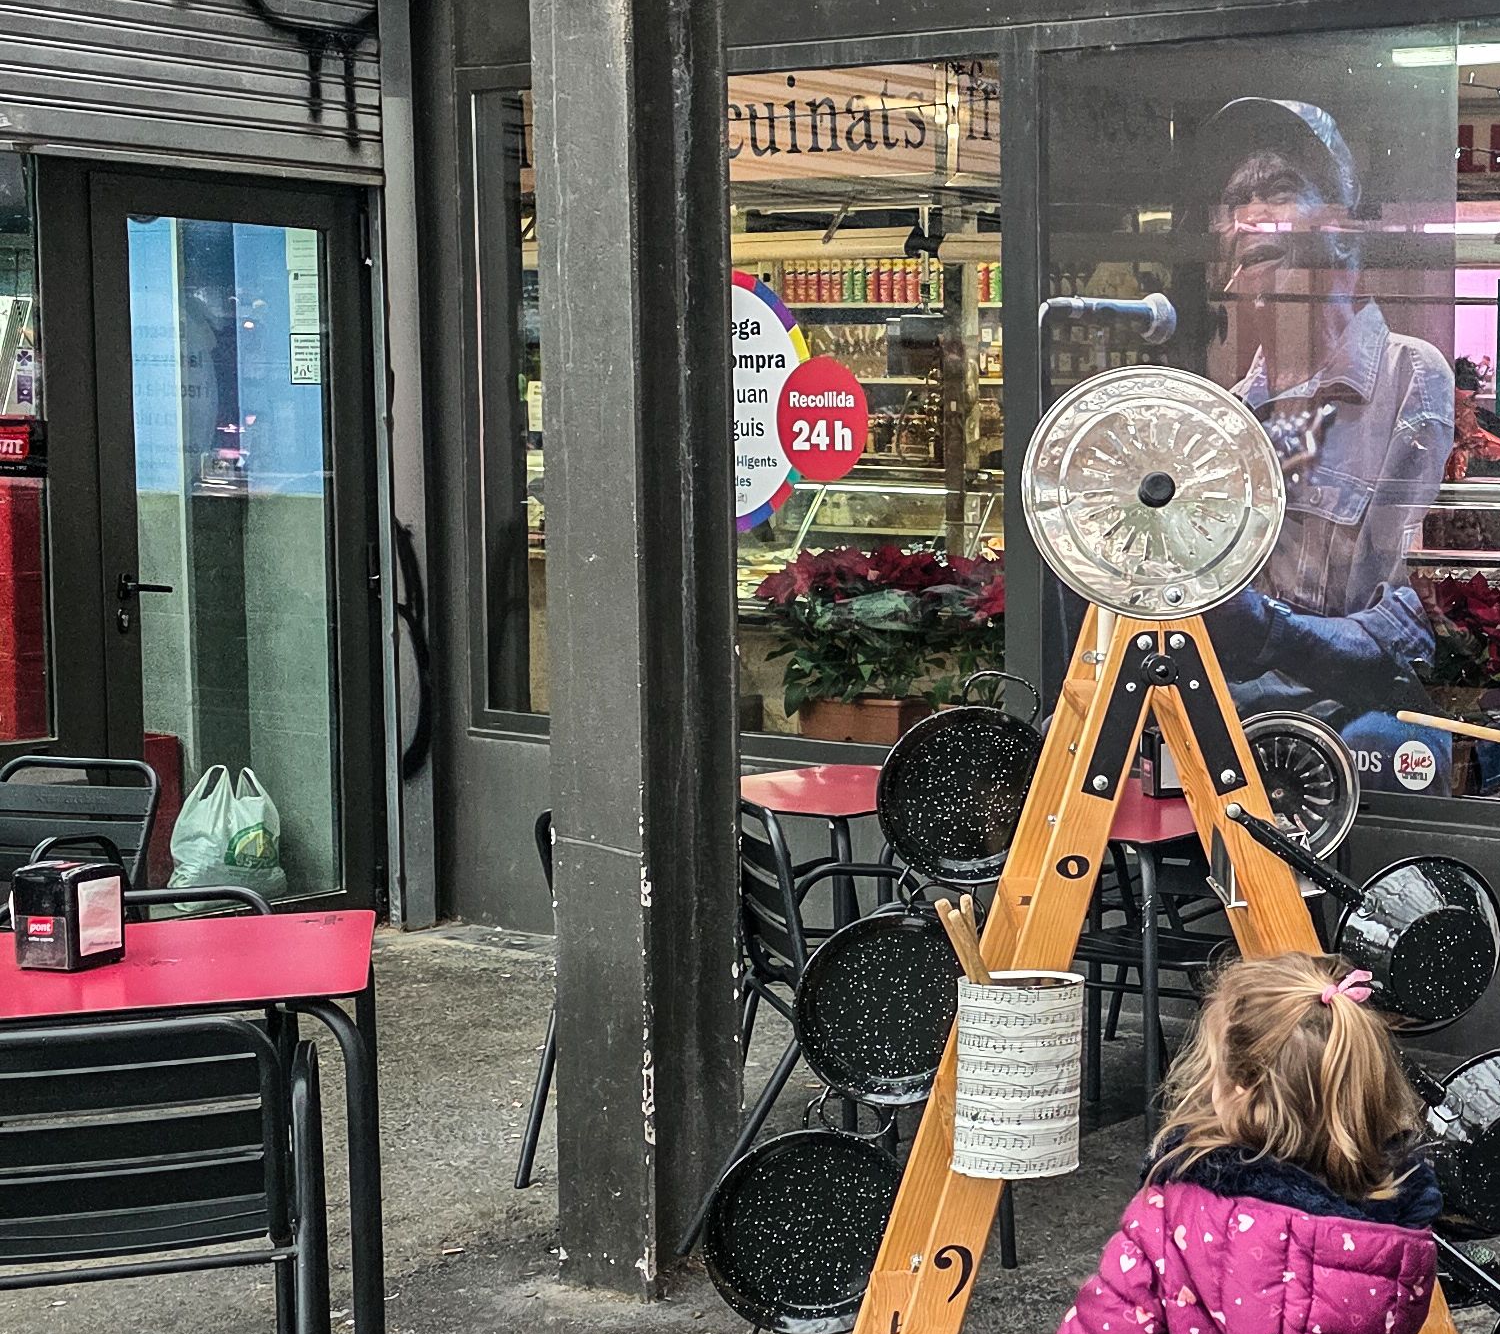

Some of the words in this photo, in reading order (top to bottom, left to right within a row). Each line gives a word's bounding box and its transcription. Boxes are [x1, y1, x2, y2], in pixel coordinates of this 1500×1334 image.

[789, 391, 855, 408] Recollida
[792, 419, 830, 451] 24
[834, 420, 853, 451] h
[1396, 750, 1433, 774] Blues
[29, 922, 52, 934] pont
